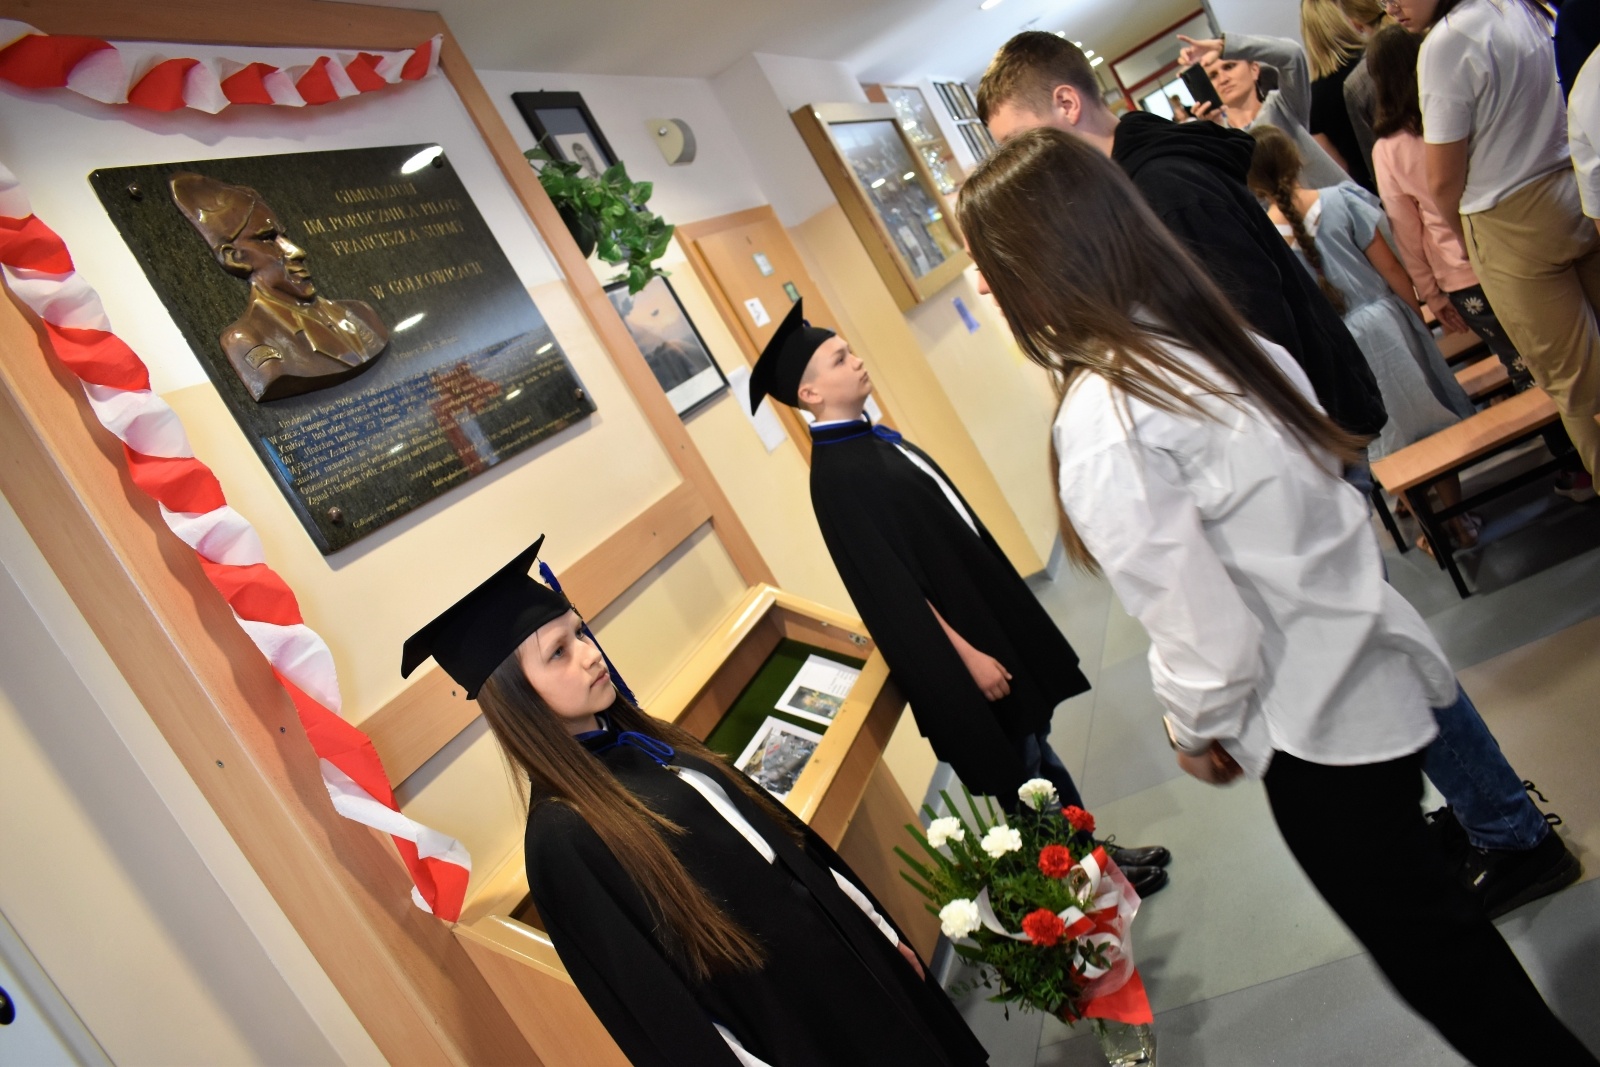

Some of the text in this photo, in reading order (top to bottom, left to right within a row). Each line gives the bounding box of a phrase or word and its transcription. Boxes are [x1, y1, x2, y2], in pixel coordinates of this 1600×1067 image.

[334, 183, 417, 204] GIMNAZJUM
[329, 206, 419, 232] PORUCZNIKA
[421, 199, 463, 216] PILOTA
[331, 220, 464, 257] FRANCISZKA SURMY
[369, 285, 385, 300] W
